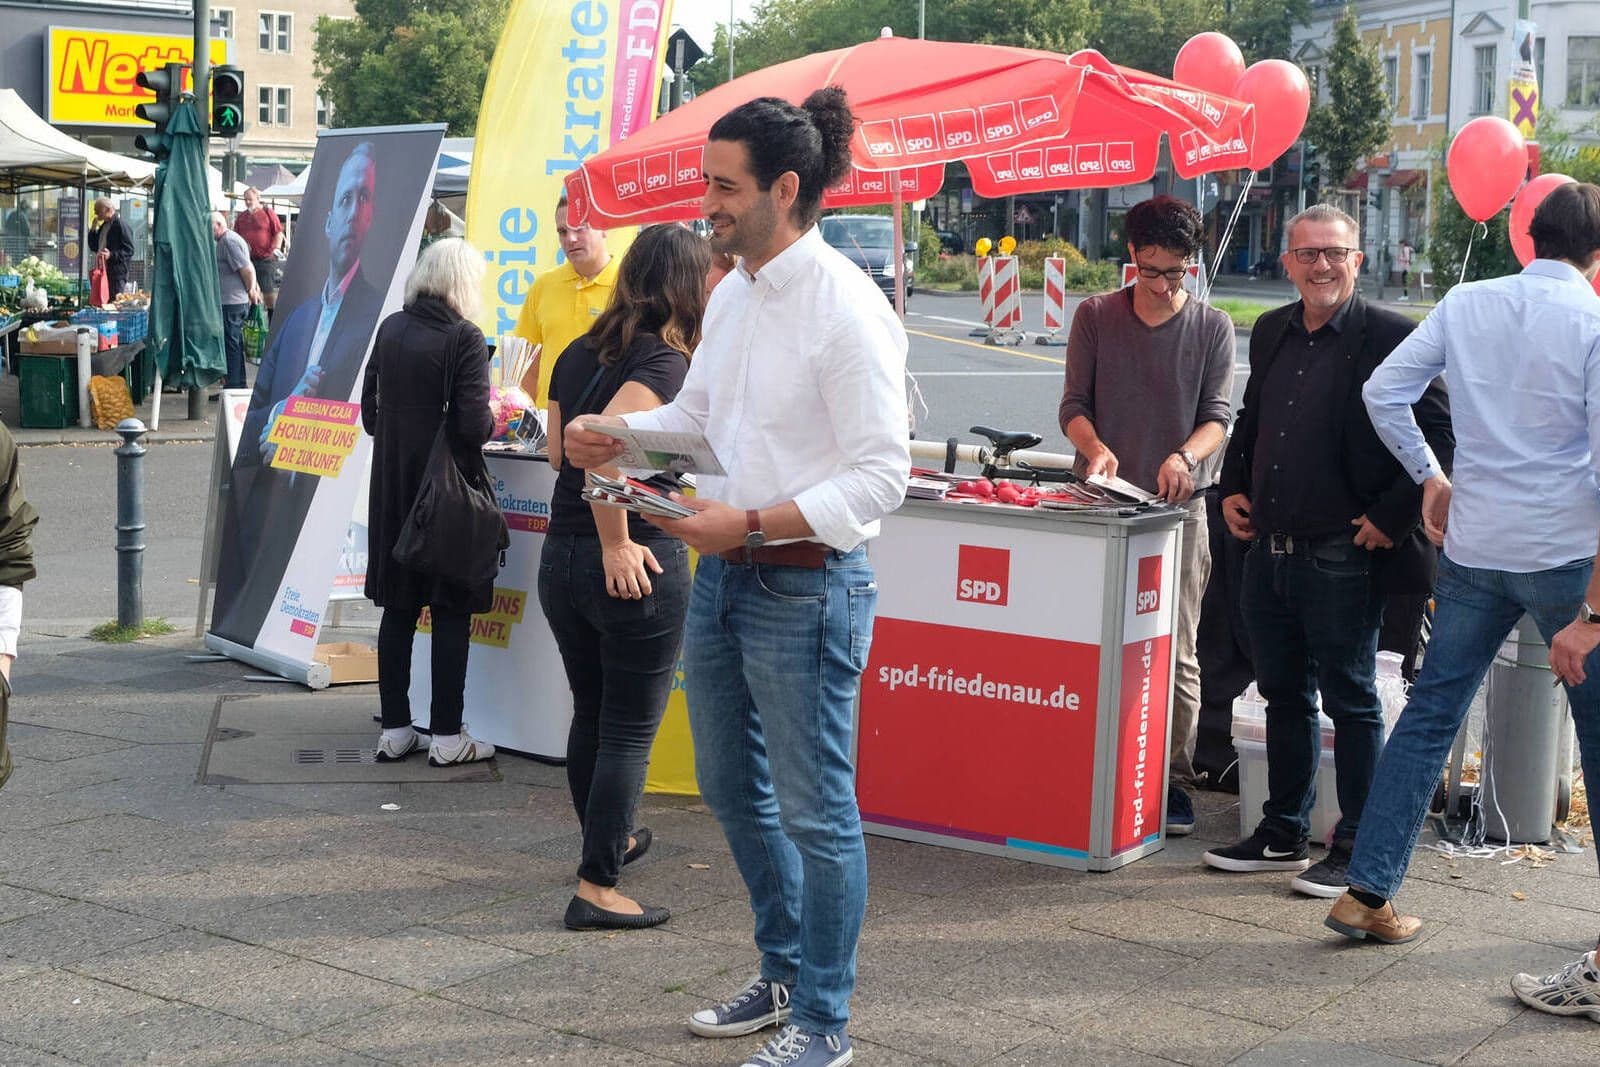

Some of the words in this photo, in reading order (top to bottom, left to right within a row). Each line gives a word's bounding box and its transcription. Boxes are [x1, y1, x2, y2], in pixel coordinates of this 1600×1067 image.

[546, 0, 609, 176] krate
[870, 142, 895, 154] SPD
[906, 137, 932, 150] SPD
[947, 131, 973, 145] SPD
[986, 124, 1013, 138] SPD
[1027, 111, 1053, 127] SPD
[617, 181, 637, 197] SPD
[646, 174, 667, 188] SPD
[677, 167, 699, 181] SPD
[274, 421, 311, 442] HOLEN
[310, 426, 332, 446] WIR
[332, 429, 356, 449] UNS
[278, 446, 297, 464] DIE
[296, 448, 342, 472] ZUKUNFT.
[528, 518, 546, 531] FDP
[959, 579, 1001, 602] SPD
[1137, 590, 1158, 611] SPD
[879, 664, 1080, 711] spd-friedenau.de
[1133, 640, 1152, 838] spd-friedenau.de
